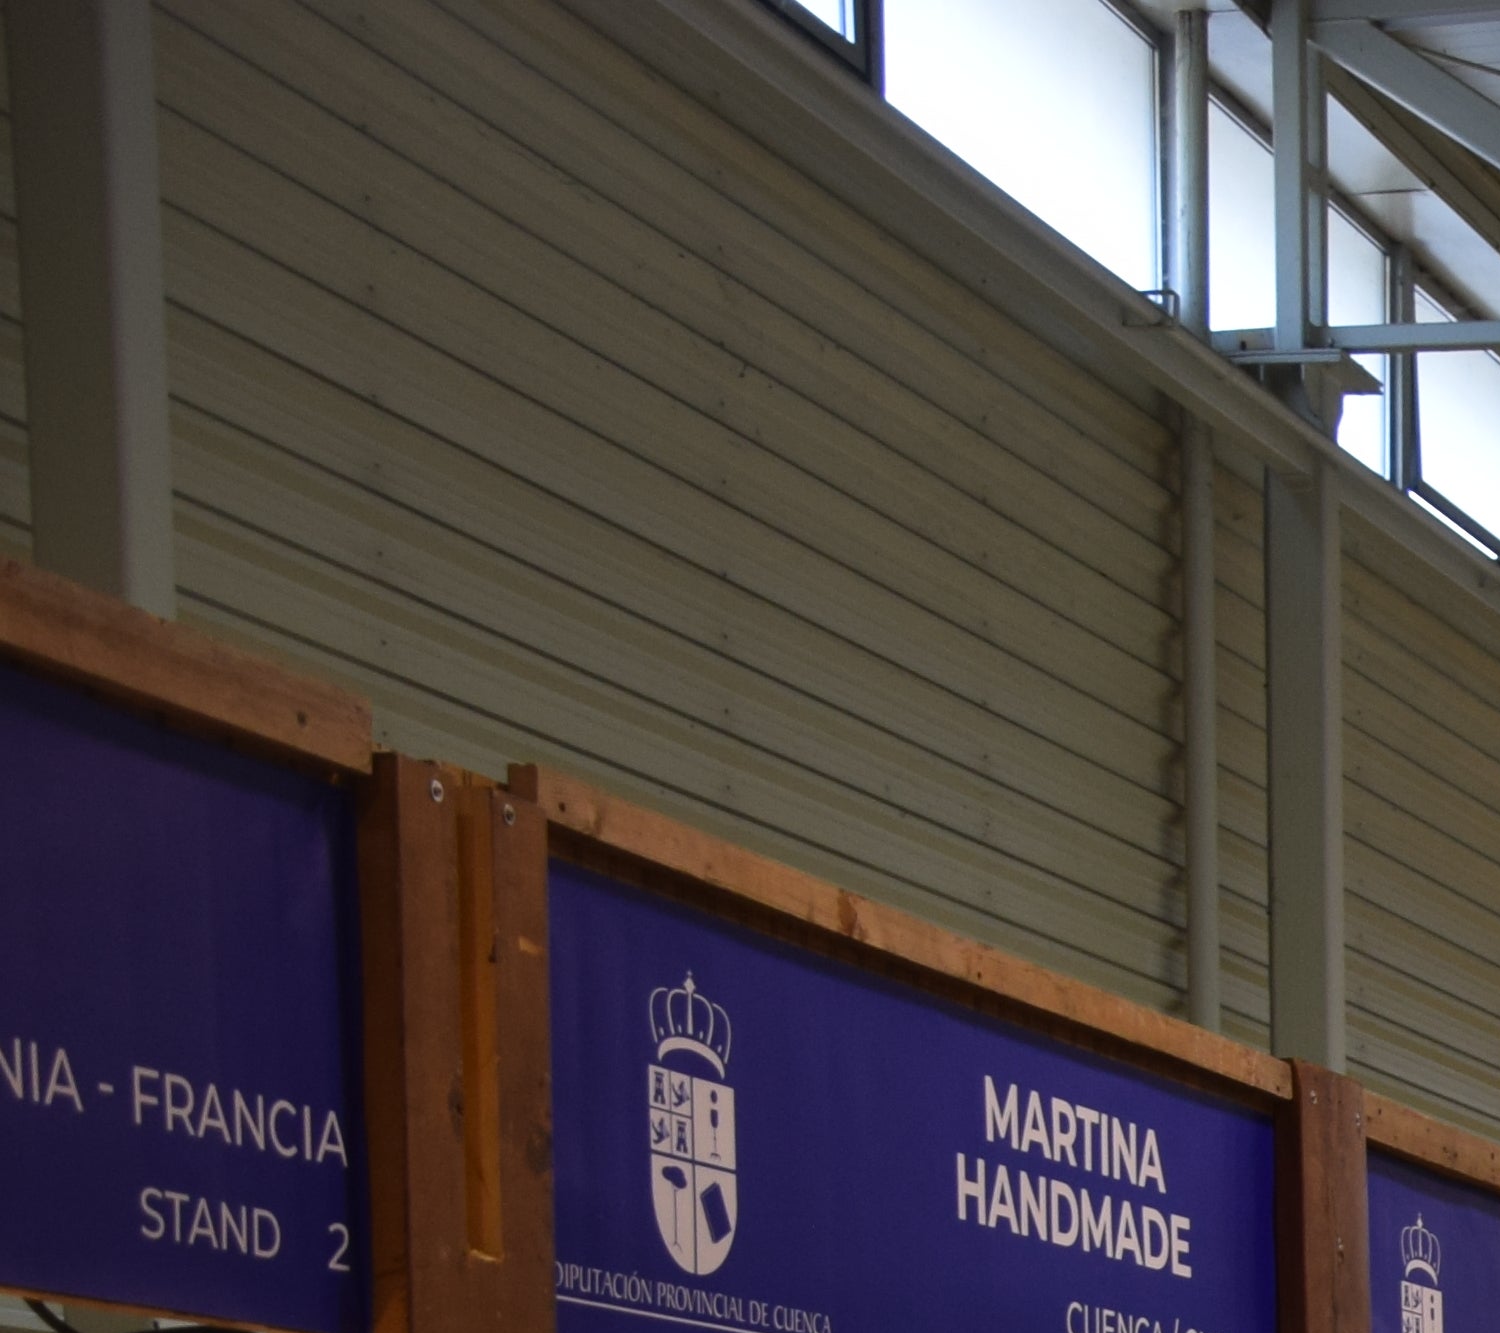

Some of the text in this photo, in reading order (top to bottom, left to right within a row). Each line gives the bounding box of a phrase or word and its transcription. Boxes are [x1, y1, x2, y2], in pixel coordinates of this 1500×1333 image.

[131, 1065, 348, 1168] FRANCIA
[984, 1075, 1166, 1194] MARTINA
[140, 1187, 350, 1272] STAND 2
[956, 1152, 1192, 1278] HANDMADE
[657, 1282, 746, 1322] PROVINCIAL
[749, 1300, 770, 1327] DE
